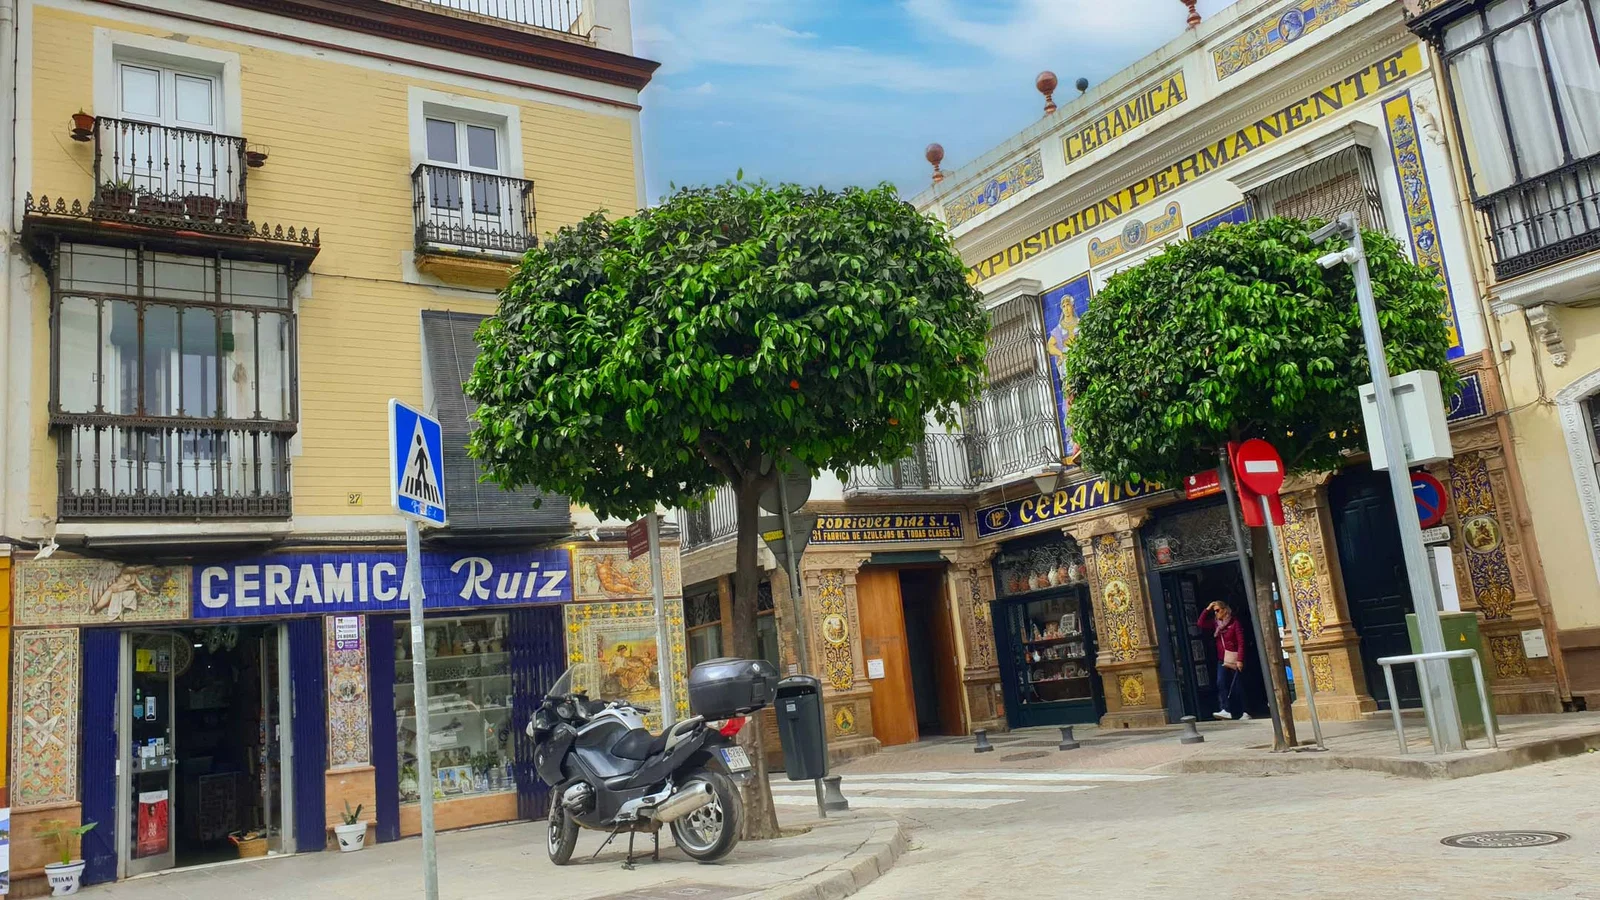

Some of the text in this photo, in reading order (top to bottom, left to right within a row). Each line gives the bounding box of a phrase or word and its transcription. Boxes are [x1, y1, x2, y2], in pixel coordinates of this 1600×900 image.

[1065, 77, 1183, 162] CERAMICA
[970, 50, 1407, 286] XPOSICION PERMANENTE
[349, 493, 361, 504] 27
[812, 526, 960, 541] 31 FABRICA DE AZULEJOS DE TODAS CLASES 31
[449, 556, 568, 601] Ruiz
[52, 875, 74, 883] TRIANA
